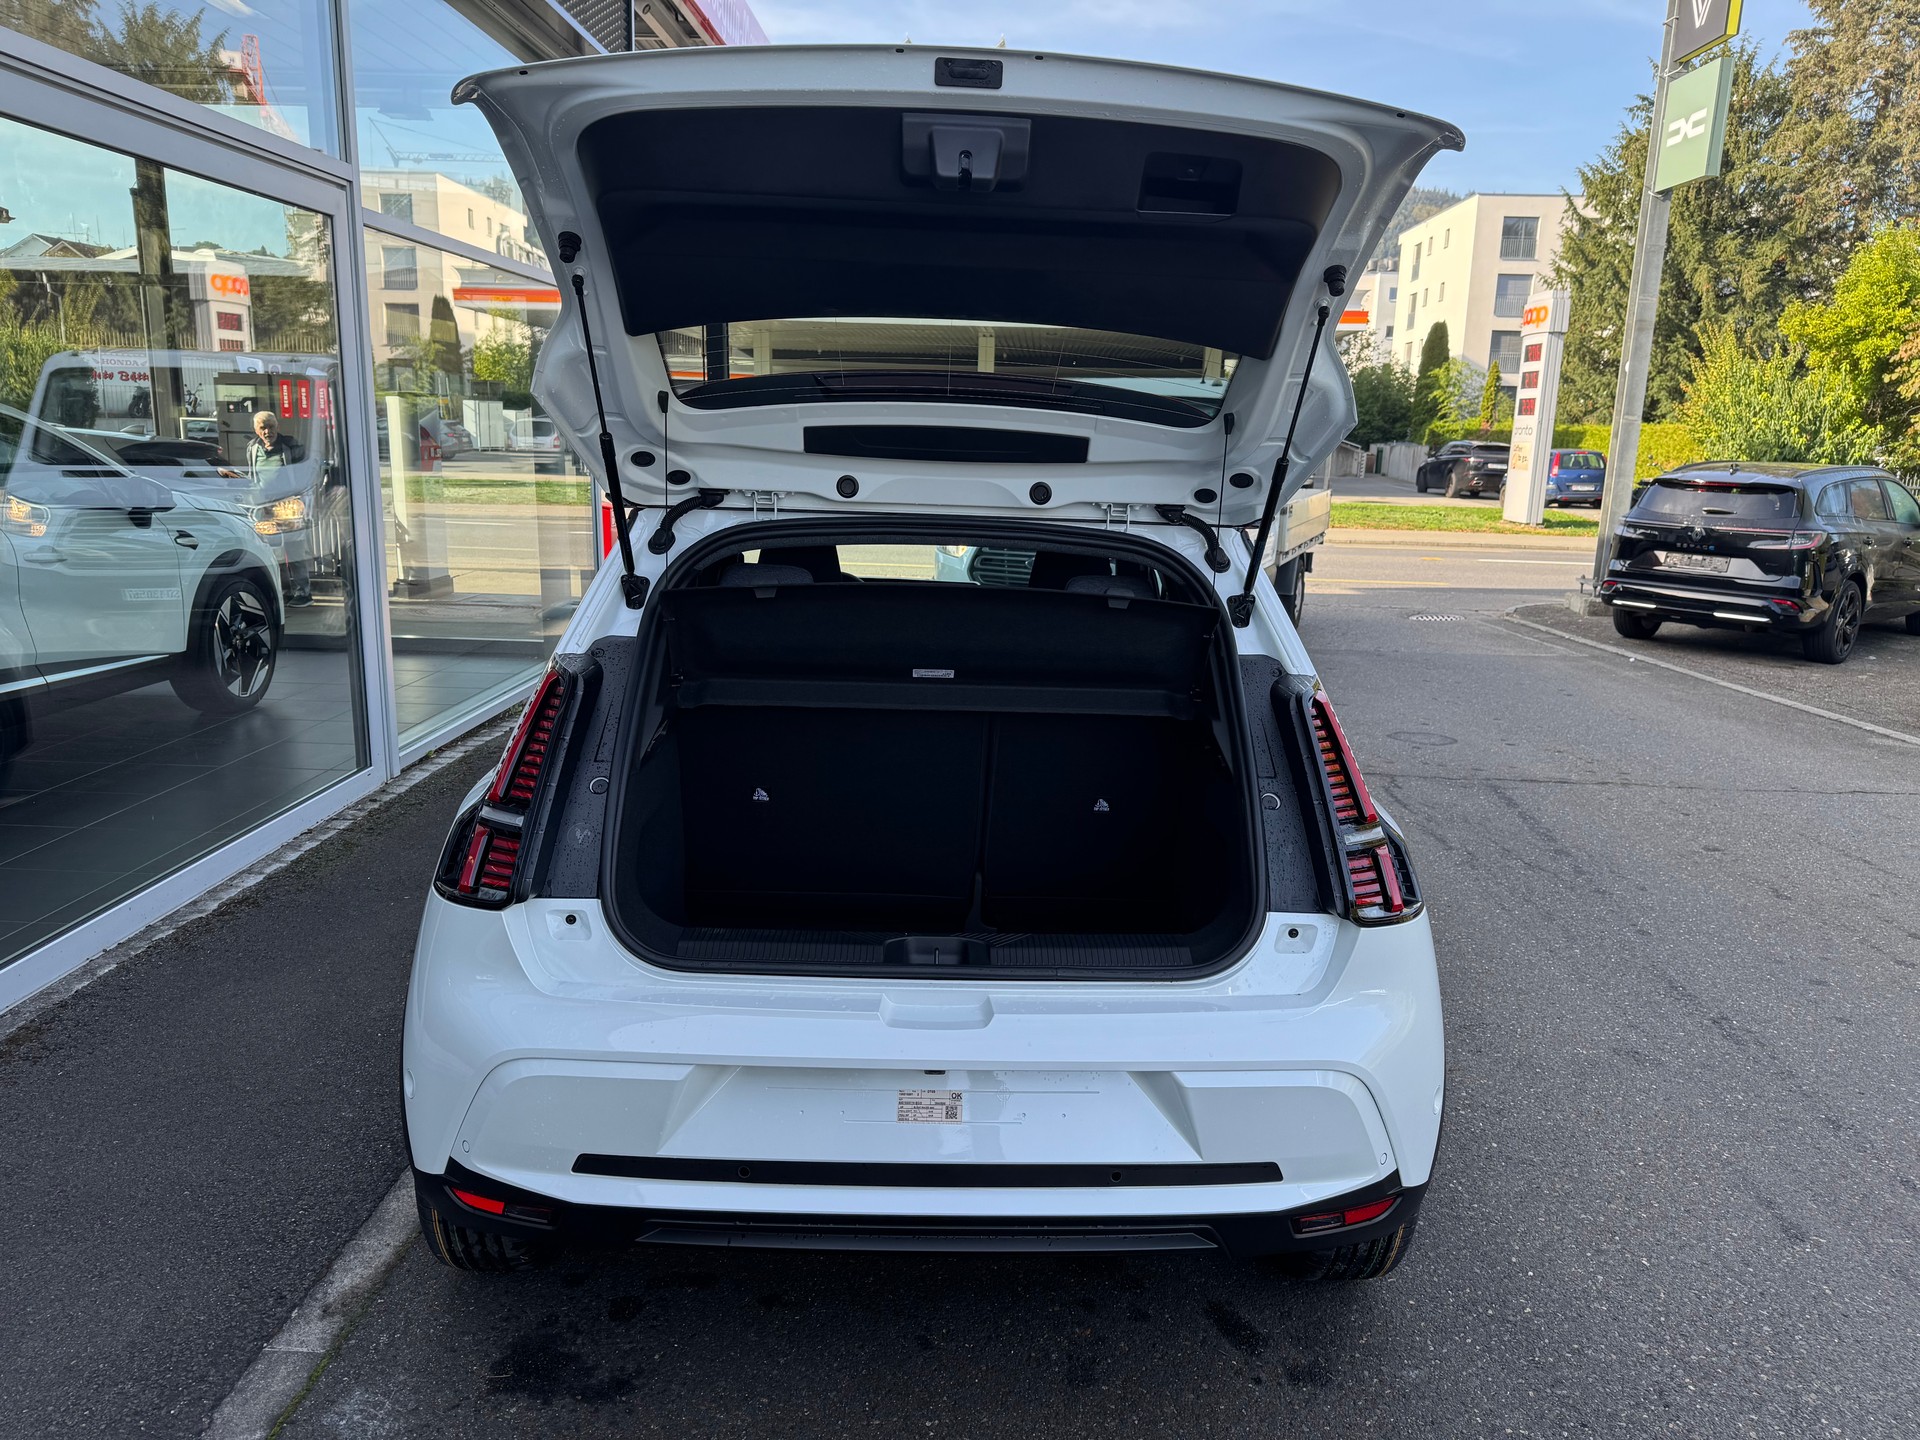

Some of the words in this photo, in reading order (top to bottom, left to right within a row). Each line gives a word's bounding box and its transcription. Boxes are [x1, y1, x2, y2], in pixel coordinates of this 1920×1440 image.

[100, 358, 139, 366] HONDA
[243, 400, 252, 412] 1
[951, 1092, 963, 1100] OK
